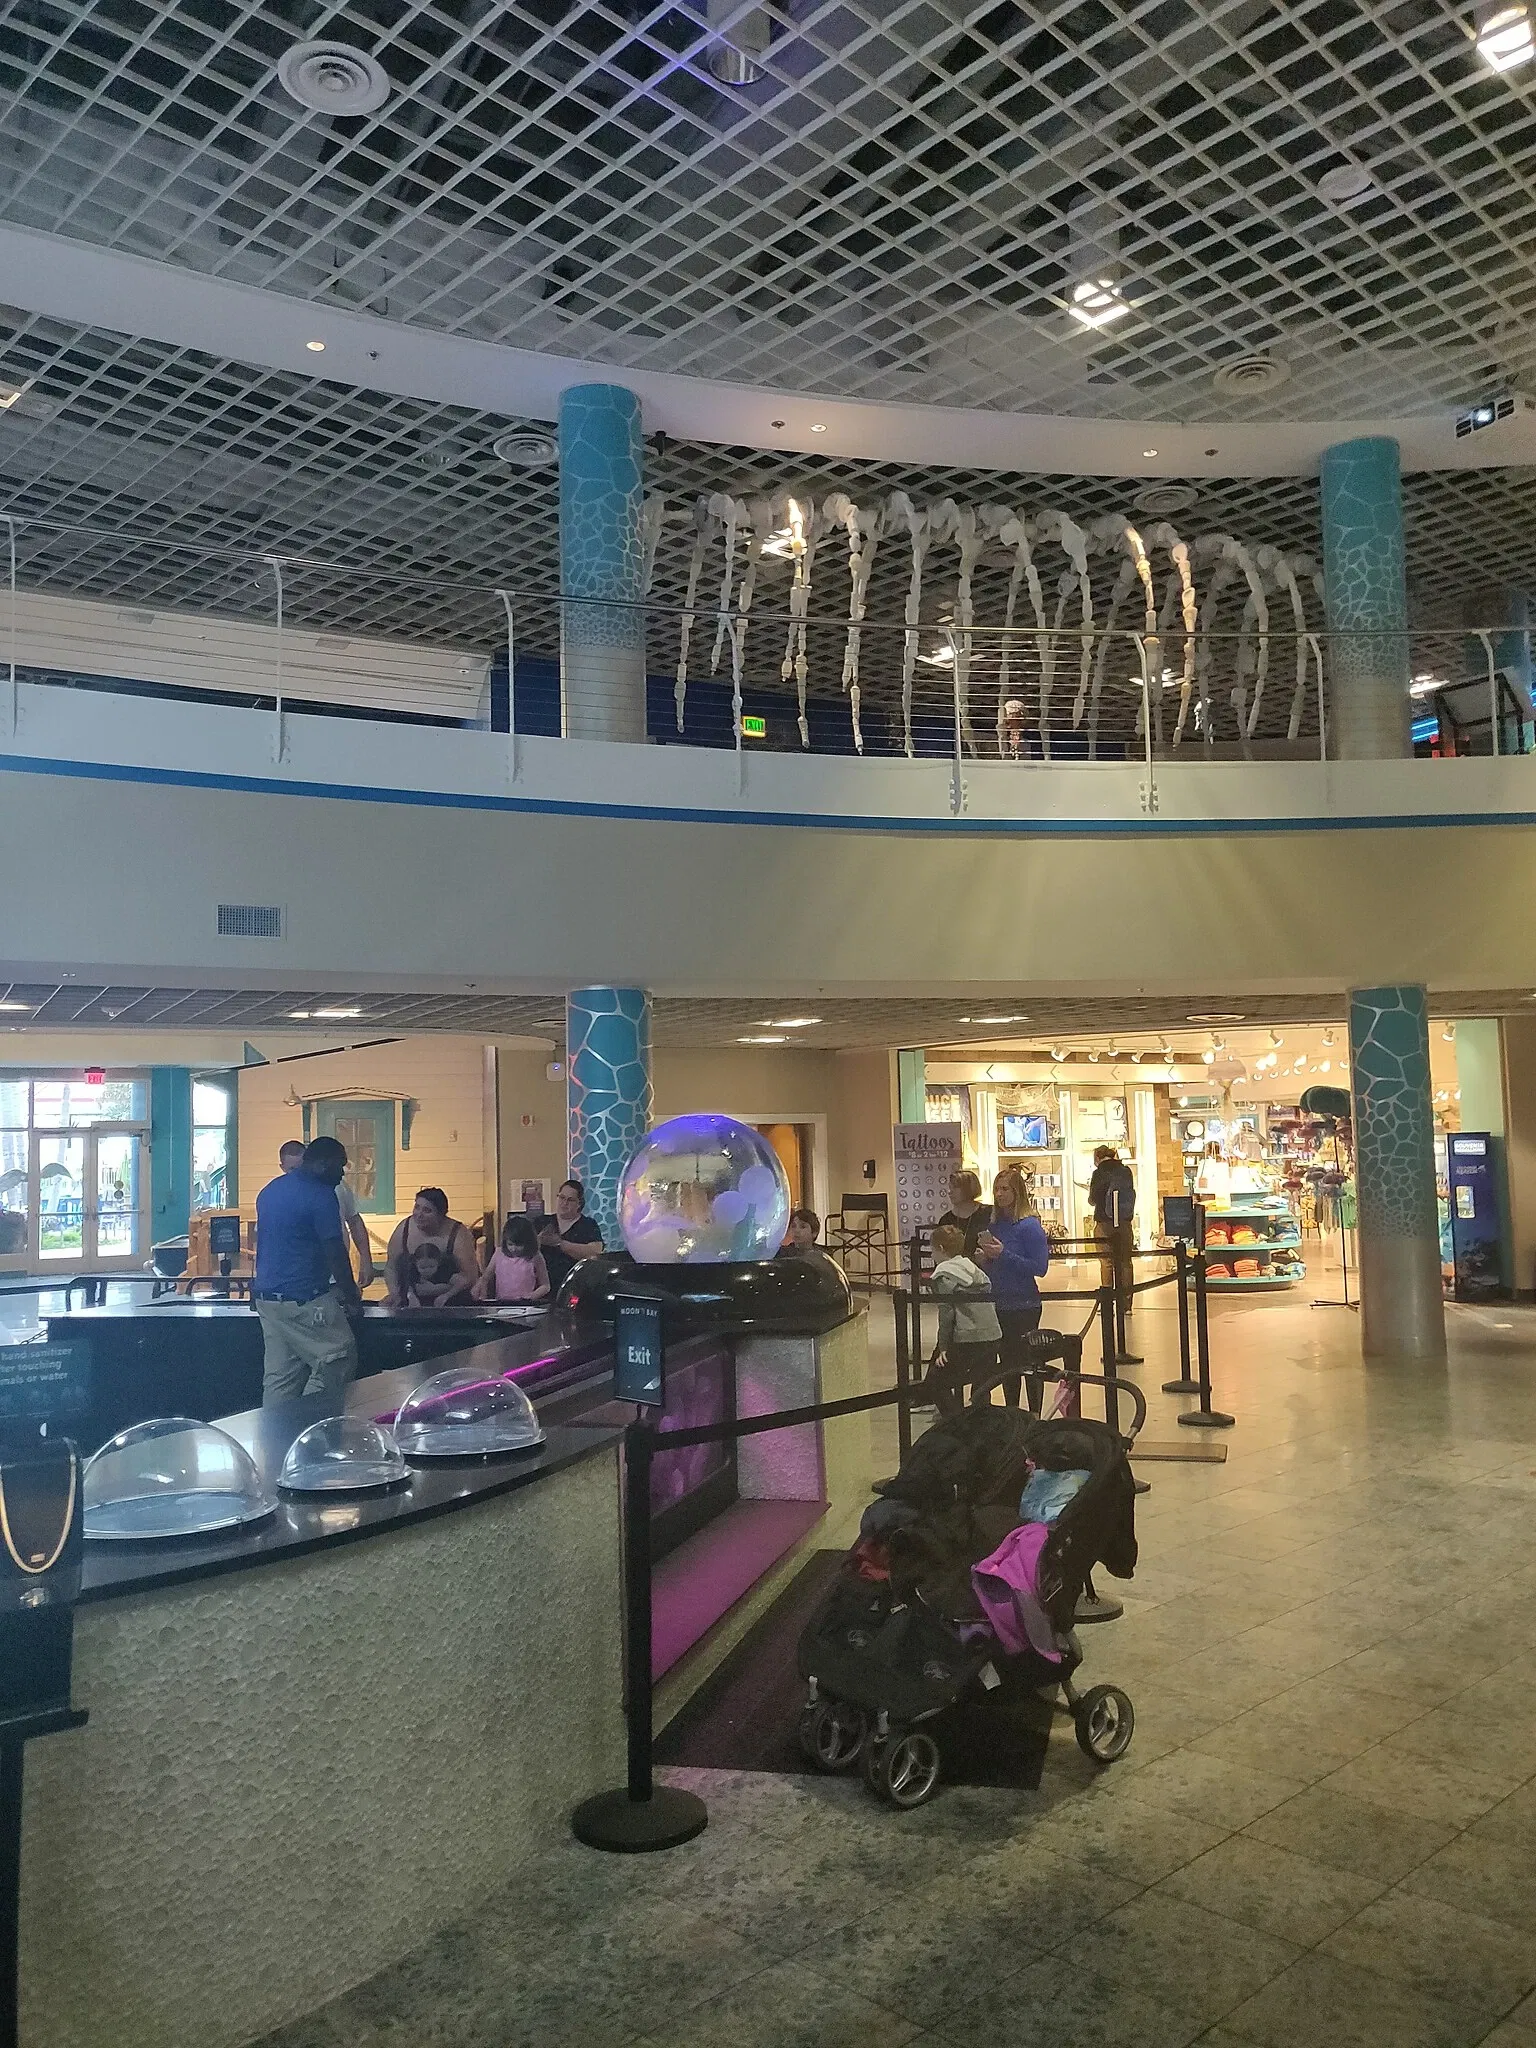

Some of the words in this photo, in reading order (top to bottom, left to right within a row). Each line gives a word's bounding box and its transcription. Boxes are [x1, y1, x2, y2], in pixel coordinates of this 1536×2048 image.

[899, 1132, 955, 1151] Tattoos
[30, 1347, 73, 1359] sanitizer
[628, 1345, 651, 1365] Exit
[26, 1375, 37, 1383] or
[40, 1371, 68, 1381] water
